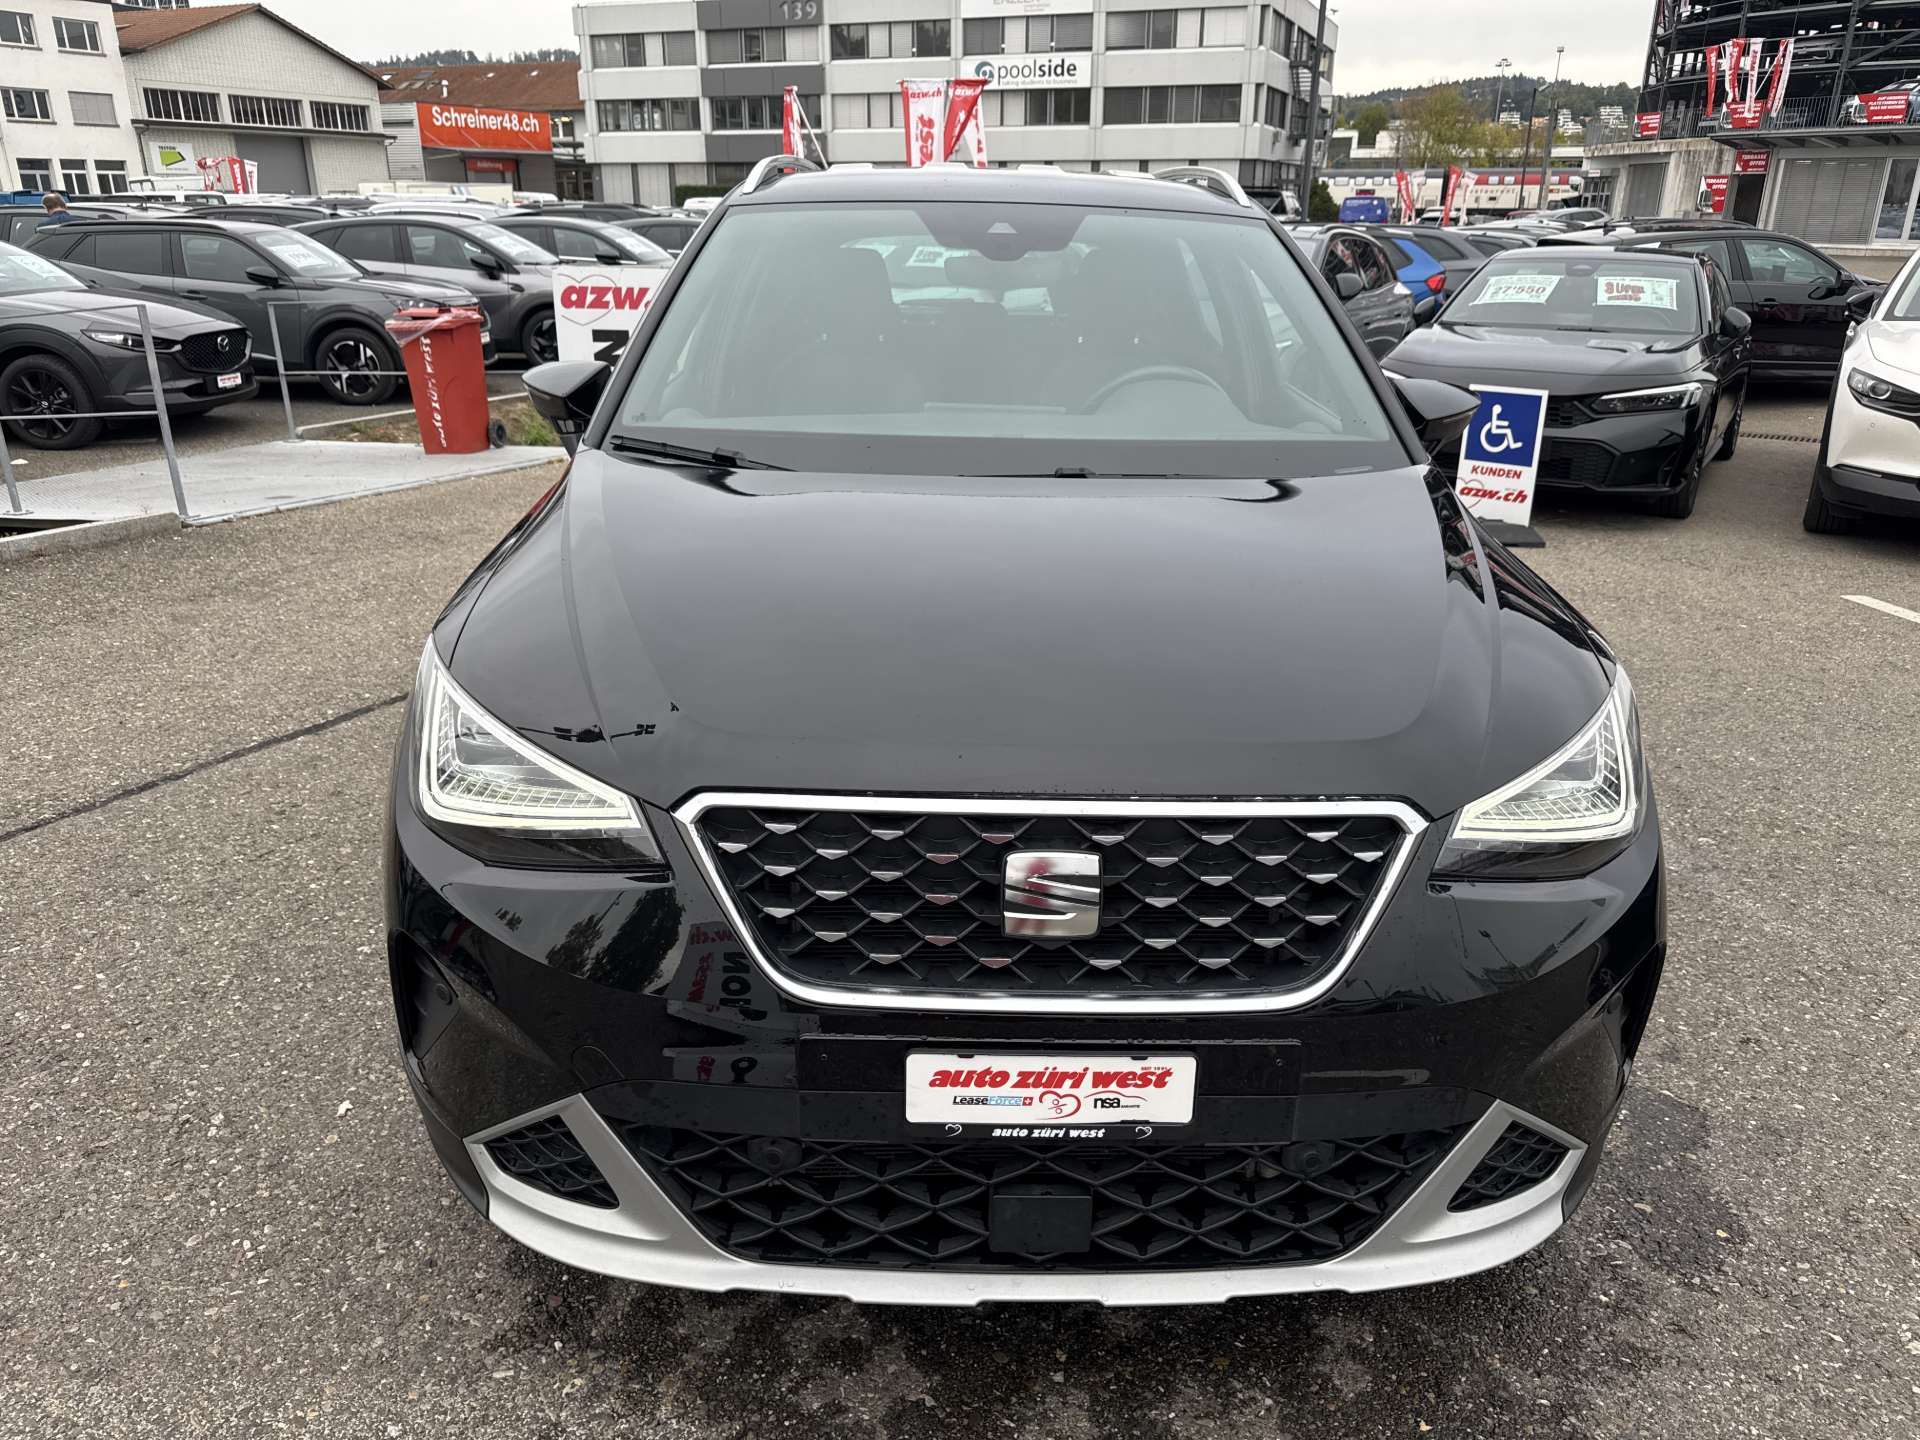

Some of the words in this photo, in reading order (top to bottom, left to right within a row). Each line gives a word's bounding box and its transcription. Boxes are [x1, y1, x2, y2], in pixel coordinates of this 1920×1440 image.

[779, 2, 817, 20] 139
[998, 58, 1077, 86] poolside
[910, 87, 942, 99] azw.ch
[432, 105, 540, 132] Schreiner48.ch
[1471, 465, 1522, 479] KUNDEN
[1459, 486, 1528, 504] azw.ch
[928, 1066, 1010, 1088] auto
[1010, 1067, 1089, 1089] züri
[1091, 1068, 1173, 1089] west
[952, 1095, 1022, 1106] LeaseForce
[1093, 1097, 1121, 1109] nsa
[992, 1127, 1028, 1138] auto
[1031, 1127, 1065, 1138] züri
[1069, 1128, 1106, 1138] west
